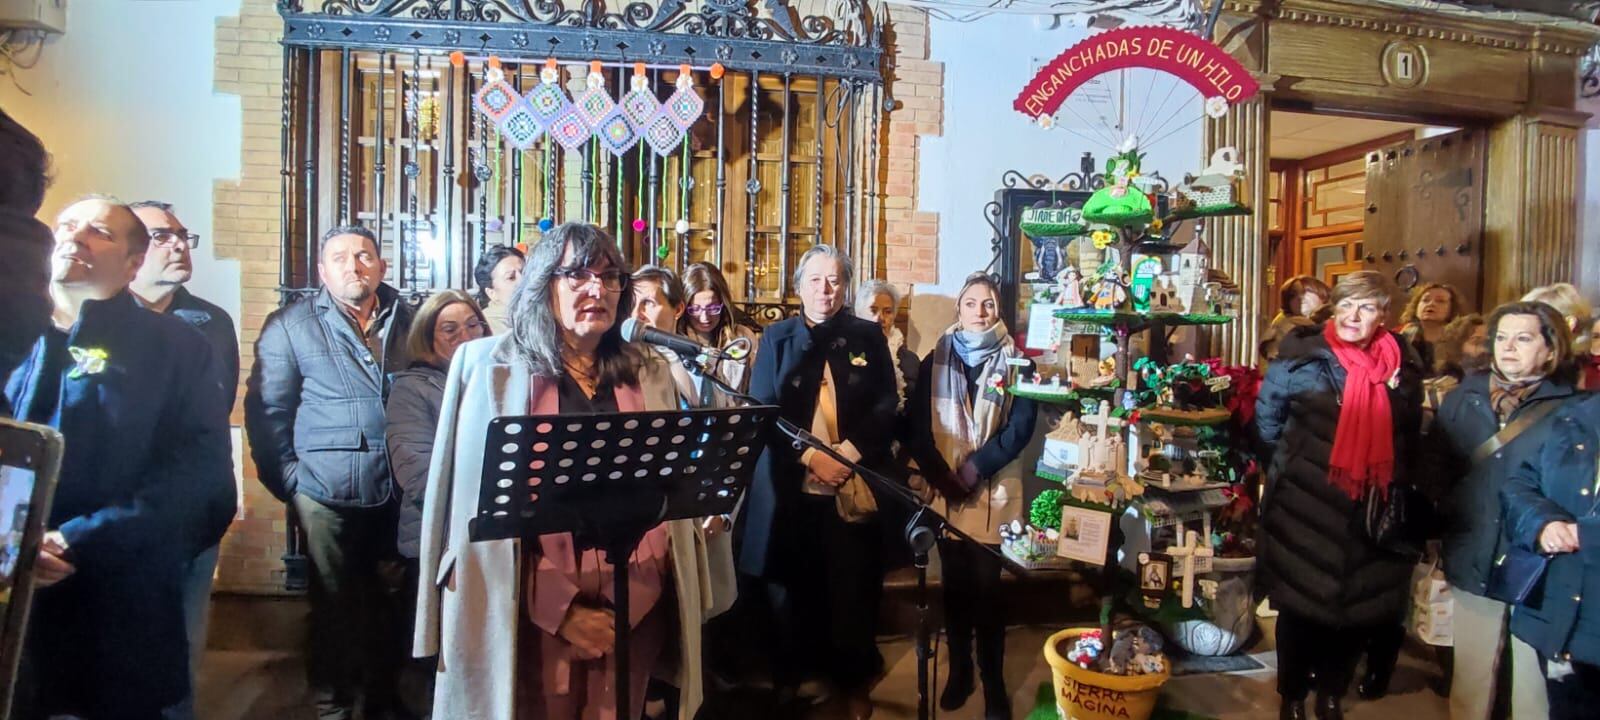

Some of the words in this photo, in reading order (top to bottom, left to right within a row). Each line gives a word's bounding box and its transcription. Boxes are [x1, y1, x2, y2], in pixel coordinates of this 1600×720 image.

[1025, 37, 1142, 116] ENGANCHADAS
[1147, 38, 1174, 59] DE
[1176, 44, 1204, 66] UN
[1200, 58, 1242, 101] HILO
[1402, 55, 1408, 76] 1
[1063, 675, 1127, 702] SIERRA
